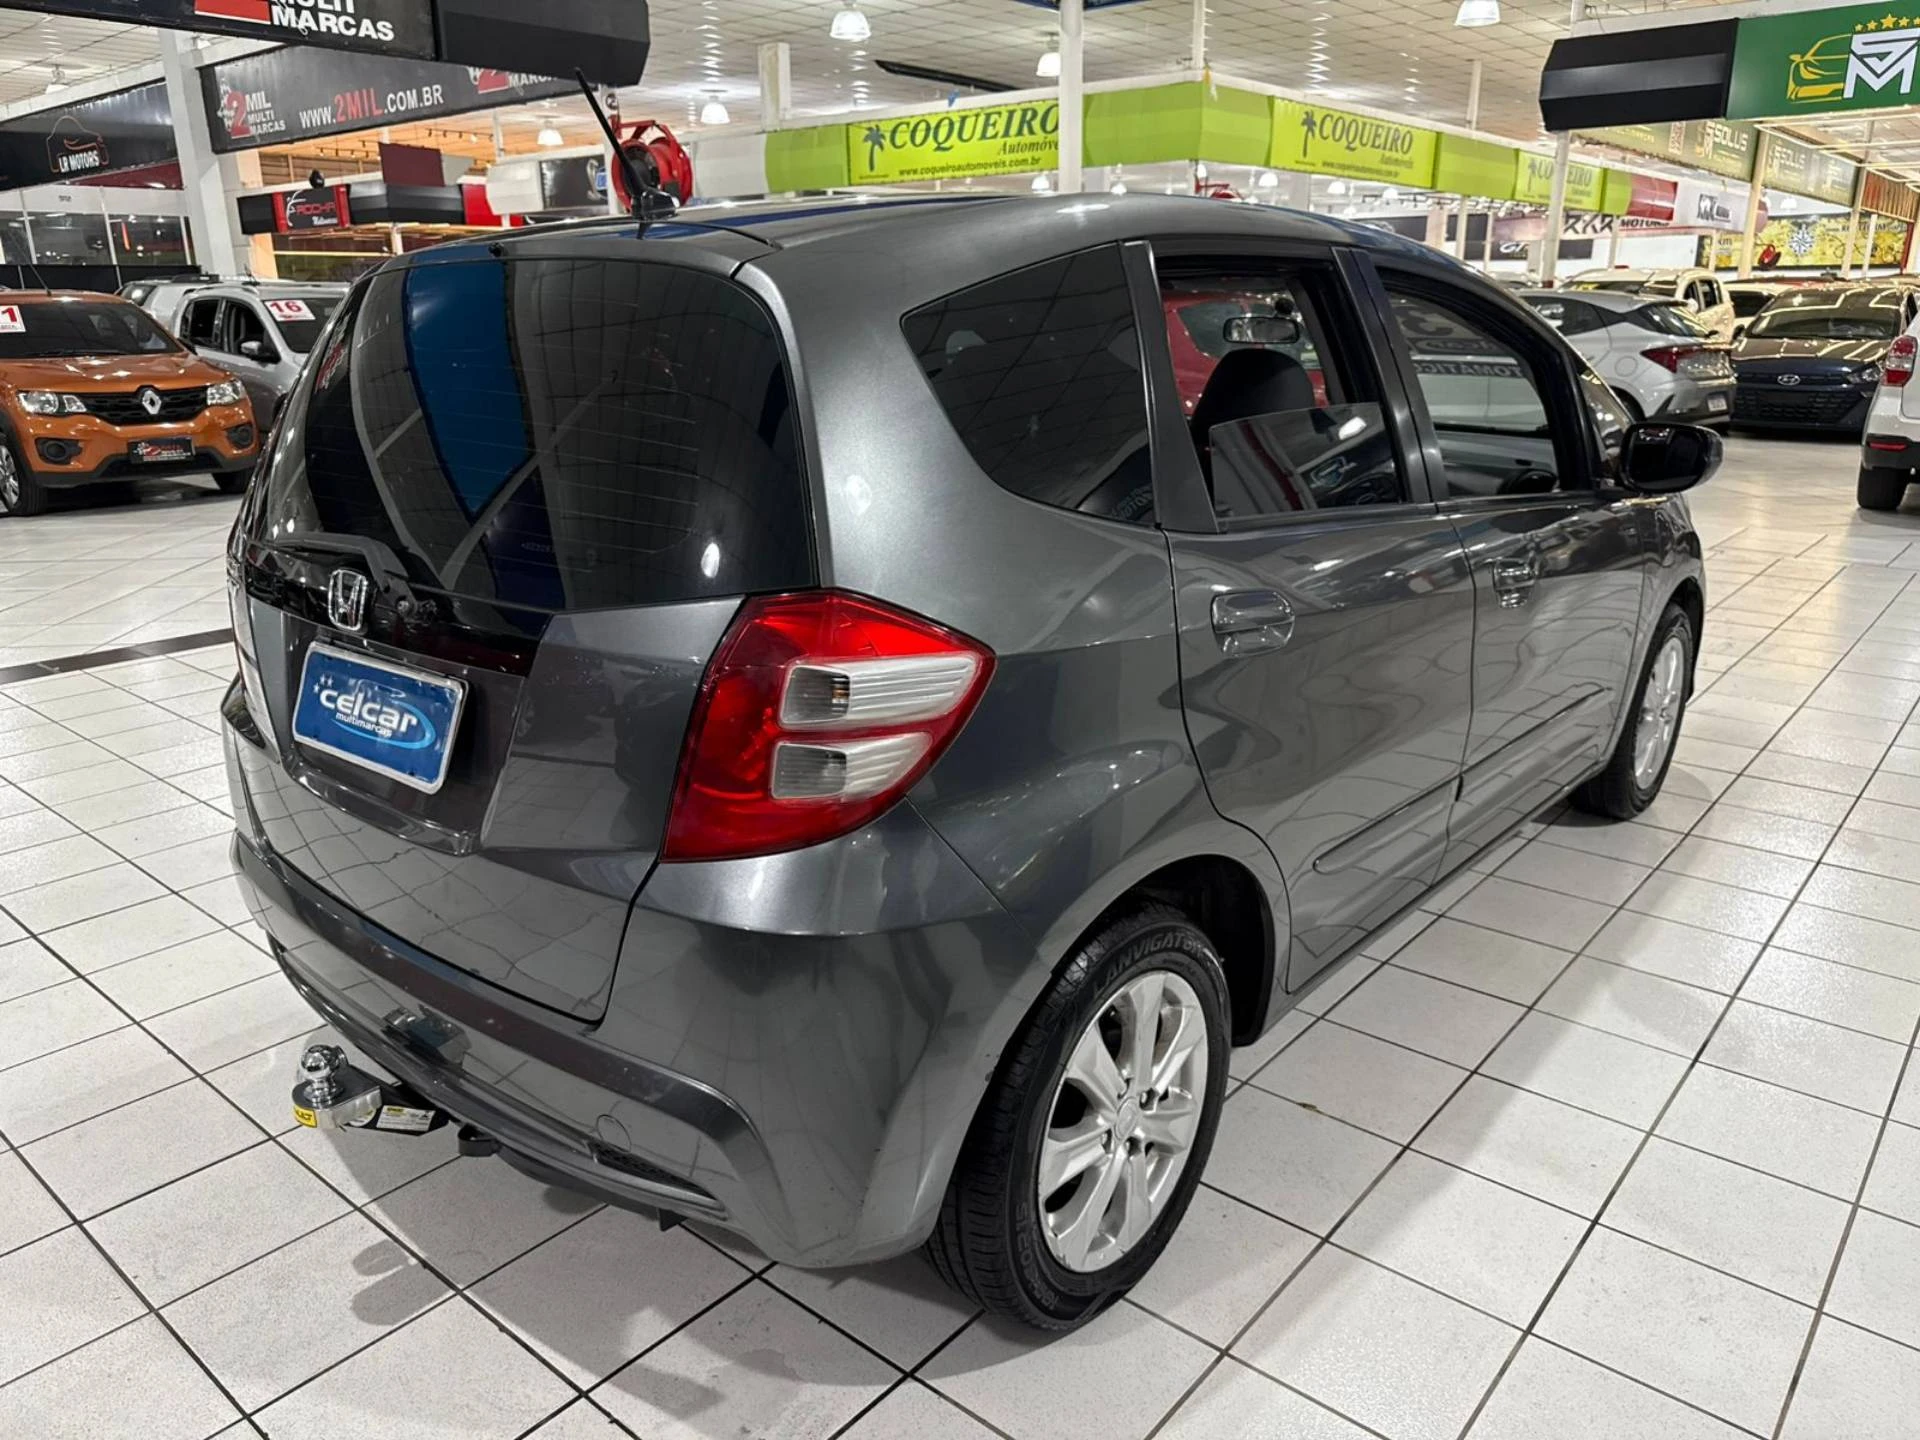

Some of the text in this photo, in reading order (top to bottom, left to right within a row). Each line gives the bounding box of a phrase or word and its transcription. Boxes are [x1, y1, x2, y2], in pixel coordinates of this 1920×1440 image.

[271, 5, 395, 41] MARCAS
[244, 90, 272, 112] MIL
[299, 84, 444, 129] WWW.2MIL.COM.BR
[248, 110, 274, 125] MULTI
[250, 120, 286, 135] MARCAS
[889, 104, 1059, 152] COQUEIRO
[1319, 113, 1413, 155] COQUEIRO
[68, 150, 100, 171] MOTORS
[270, 301, 302, 313] 16
[319, 689, 418, 733] celcar
